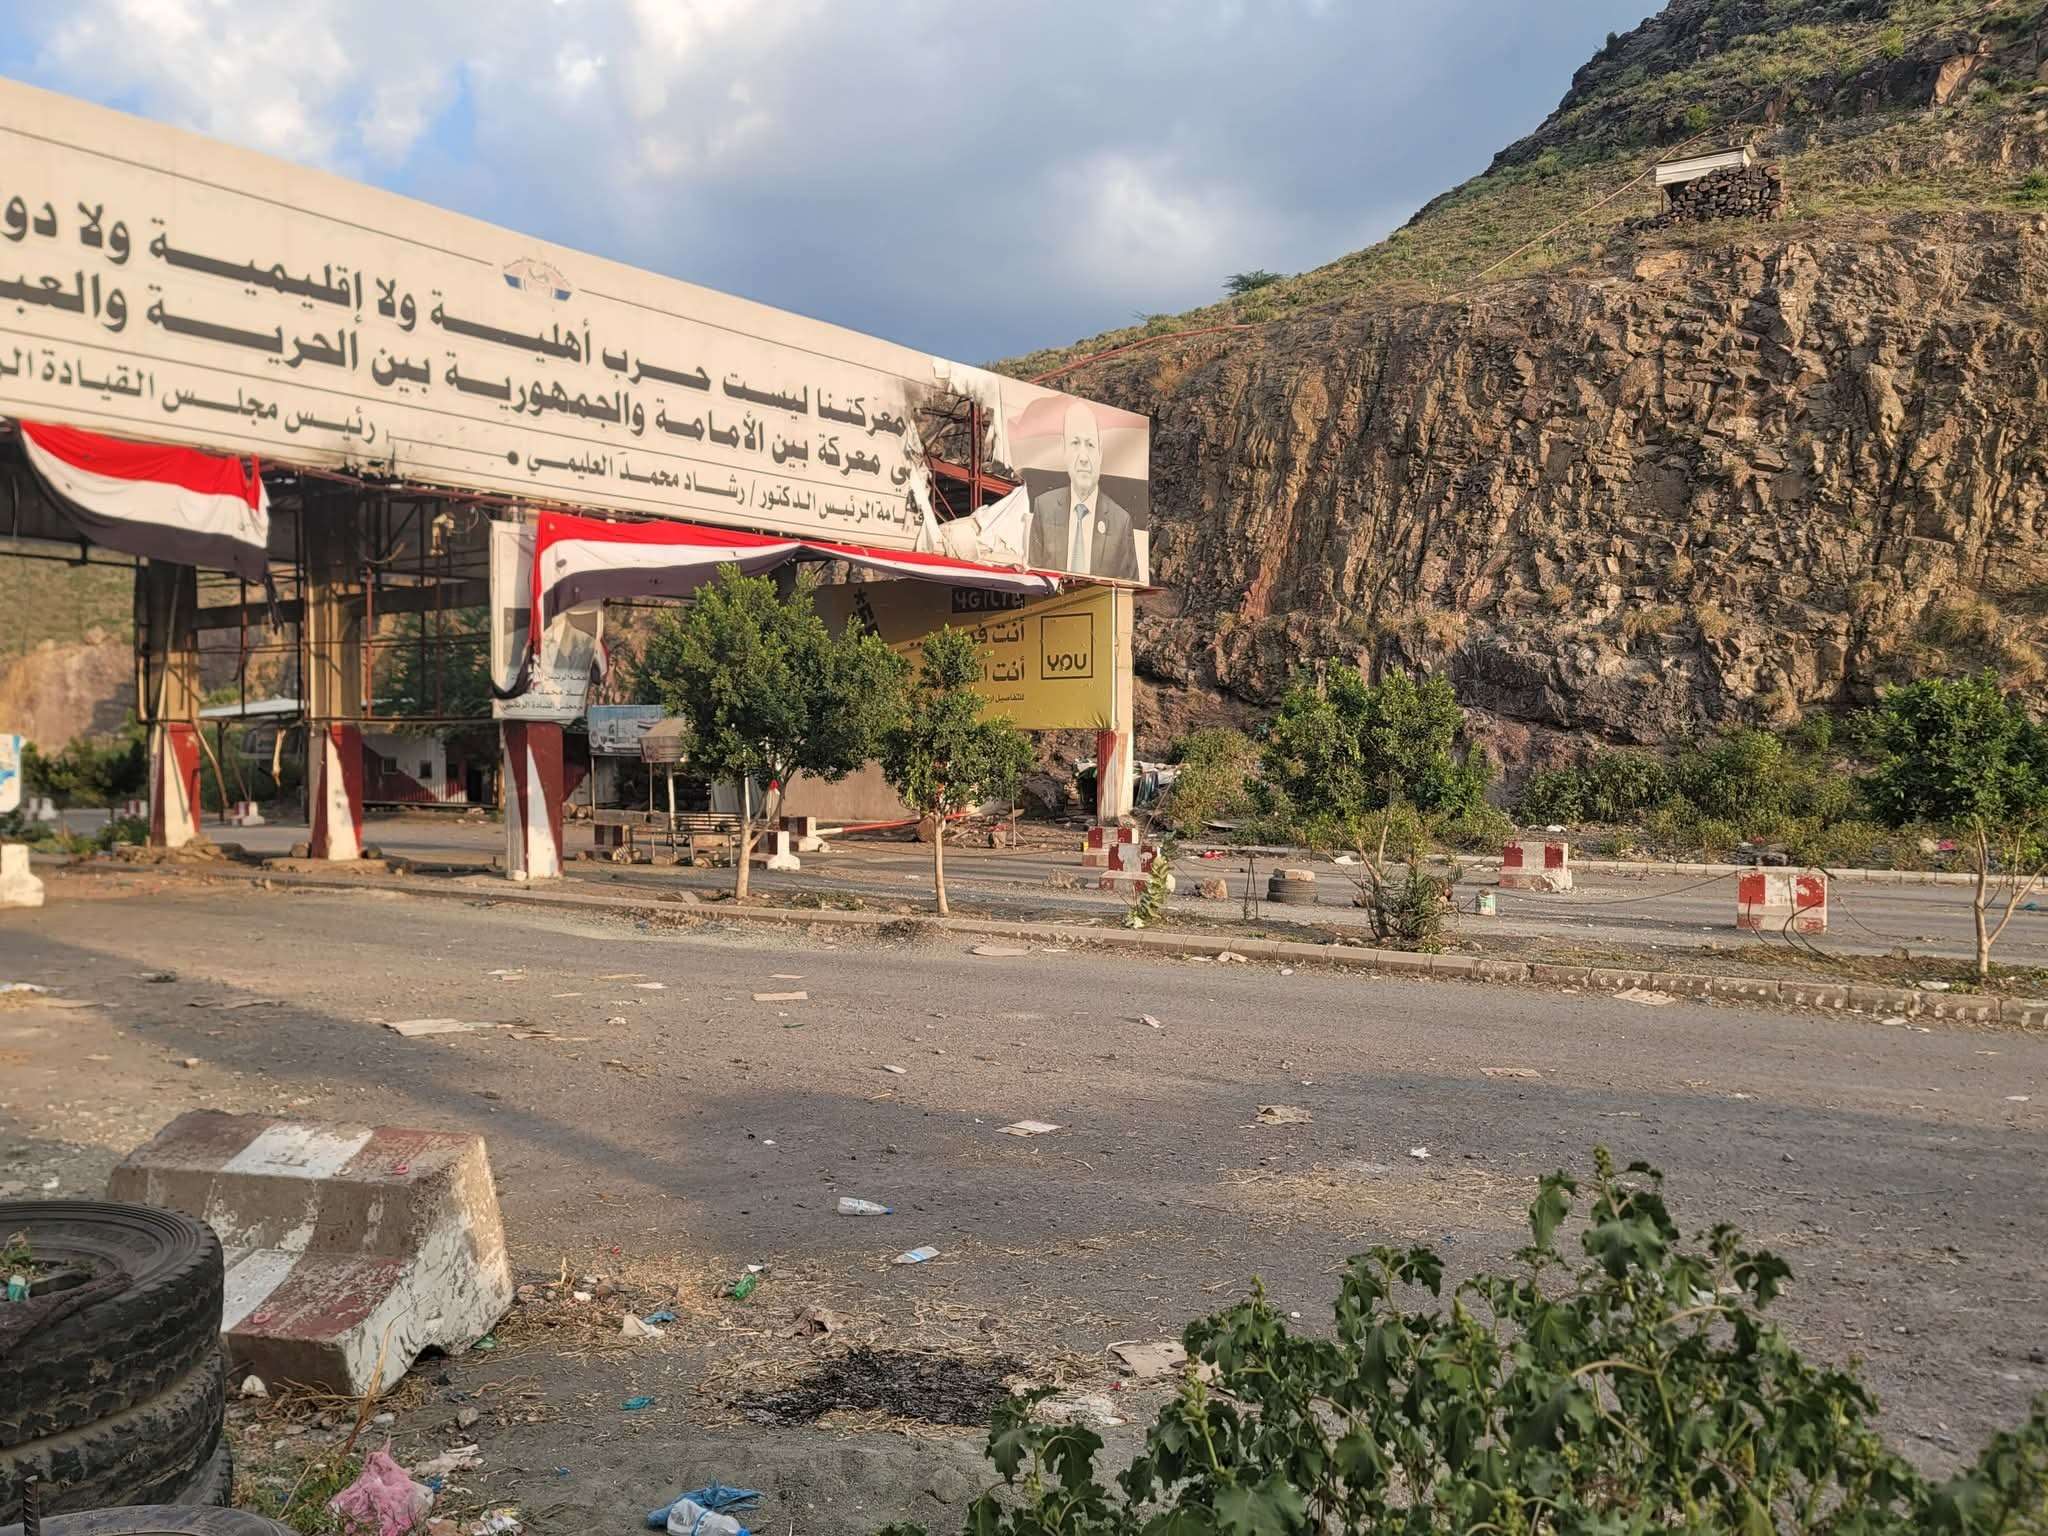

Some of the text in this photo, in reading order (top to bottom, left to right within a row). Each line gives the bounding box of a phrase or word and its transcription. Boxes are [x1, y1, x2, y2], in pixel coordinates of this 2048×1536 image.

[77, 201, 131, 266] ولا
[149, 218, 363, 324] إقليمية
[146, 284, 359, 371] الحرية
[375, 277, 417, 333] ولا
[431, 289, 591, 364] أهلية
[42, 349, 154, 401] القيادة
[371, 348, 431, 394] بين
[602, 347, 711, 392] حرب
[162, 388, 278, 427] مجلس
[444, 351, 645, 437] والجمهورية
[722, 373, 808, 420] ليست
[817, 389, 908, 438] معركتنا
[285, 406, 376, 443] رئيس
[655, 398, 764, 453] الأمامة
[526, 450, 613, 480] العليمي
[771, 433, 809, 469] بين
[817, 434, 881, 477] معركة
[619, 462, 680, 488] محمد
[684, 472, 745, 506] رشاد
[759, 485, 816, 511] الدكتور
[819, 495, 874, 524] الرئيس
[992, 656, 1025, 682] أنت
[1047, 653, 1087, 671] YOU
